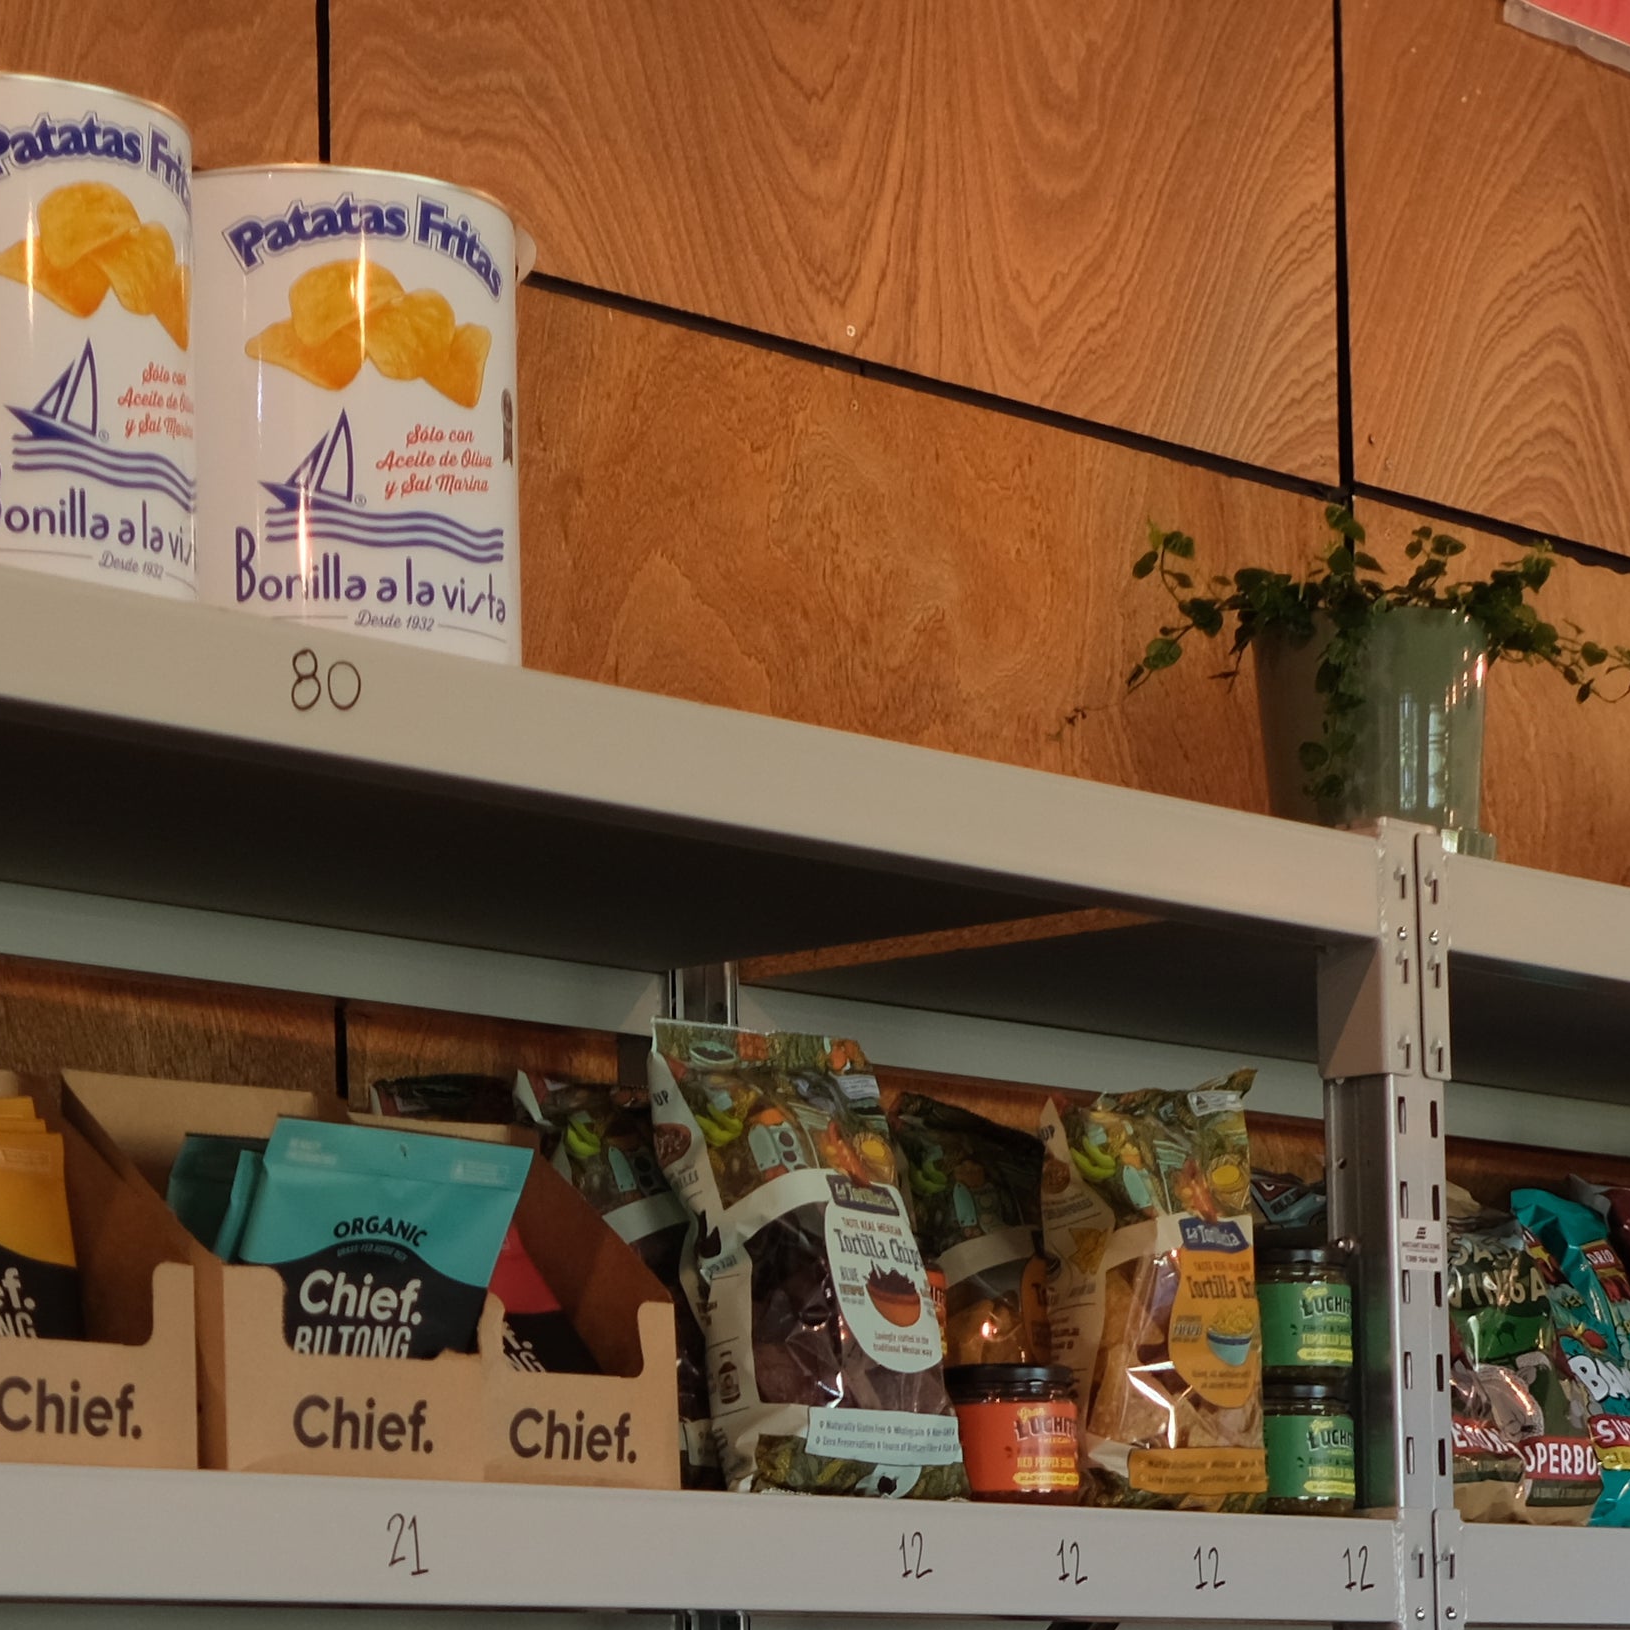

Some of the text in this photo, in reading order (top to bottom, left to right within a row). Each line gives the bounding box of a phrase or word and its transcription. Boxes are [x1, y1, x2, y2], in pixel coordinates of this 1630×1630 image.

[222, 194, 504, 301] Patatas Fritas
[376, 448, 493, 472] Aceite de Oliva
[406, 424, 475, 447] Sólo con
[385, 473, 489, 499] y Sal Marina
[118, 518, 135, 545] a
[142, 500, 163, 552] la
[236, 527, 506, 624] Bonilla a la vista
[354, 608, 435, 634] Desde 1932
[290, 649, 362, 711] 80
[333, 1216, 427, 1247] ORGANIC
[833, 1228, 888, 1260] Tortilla
[299, 1269, 422, 1325] Chief.
[293, 1394, 434, 1455] Chief.
[509, 1406, 638, 1464] Chief.
[387, 1511, 429, 1577] 21
[899, 1530, 934, 1581] 12
[1057, 1539, 1089, 1587] 12
[1194, 1544, 1226, 1592] 12
[1343, 1544, 1374, 1592] 12
